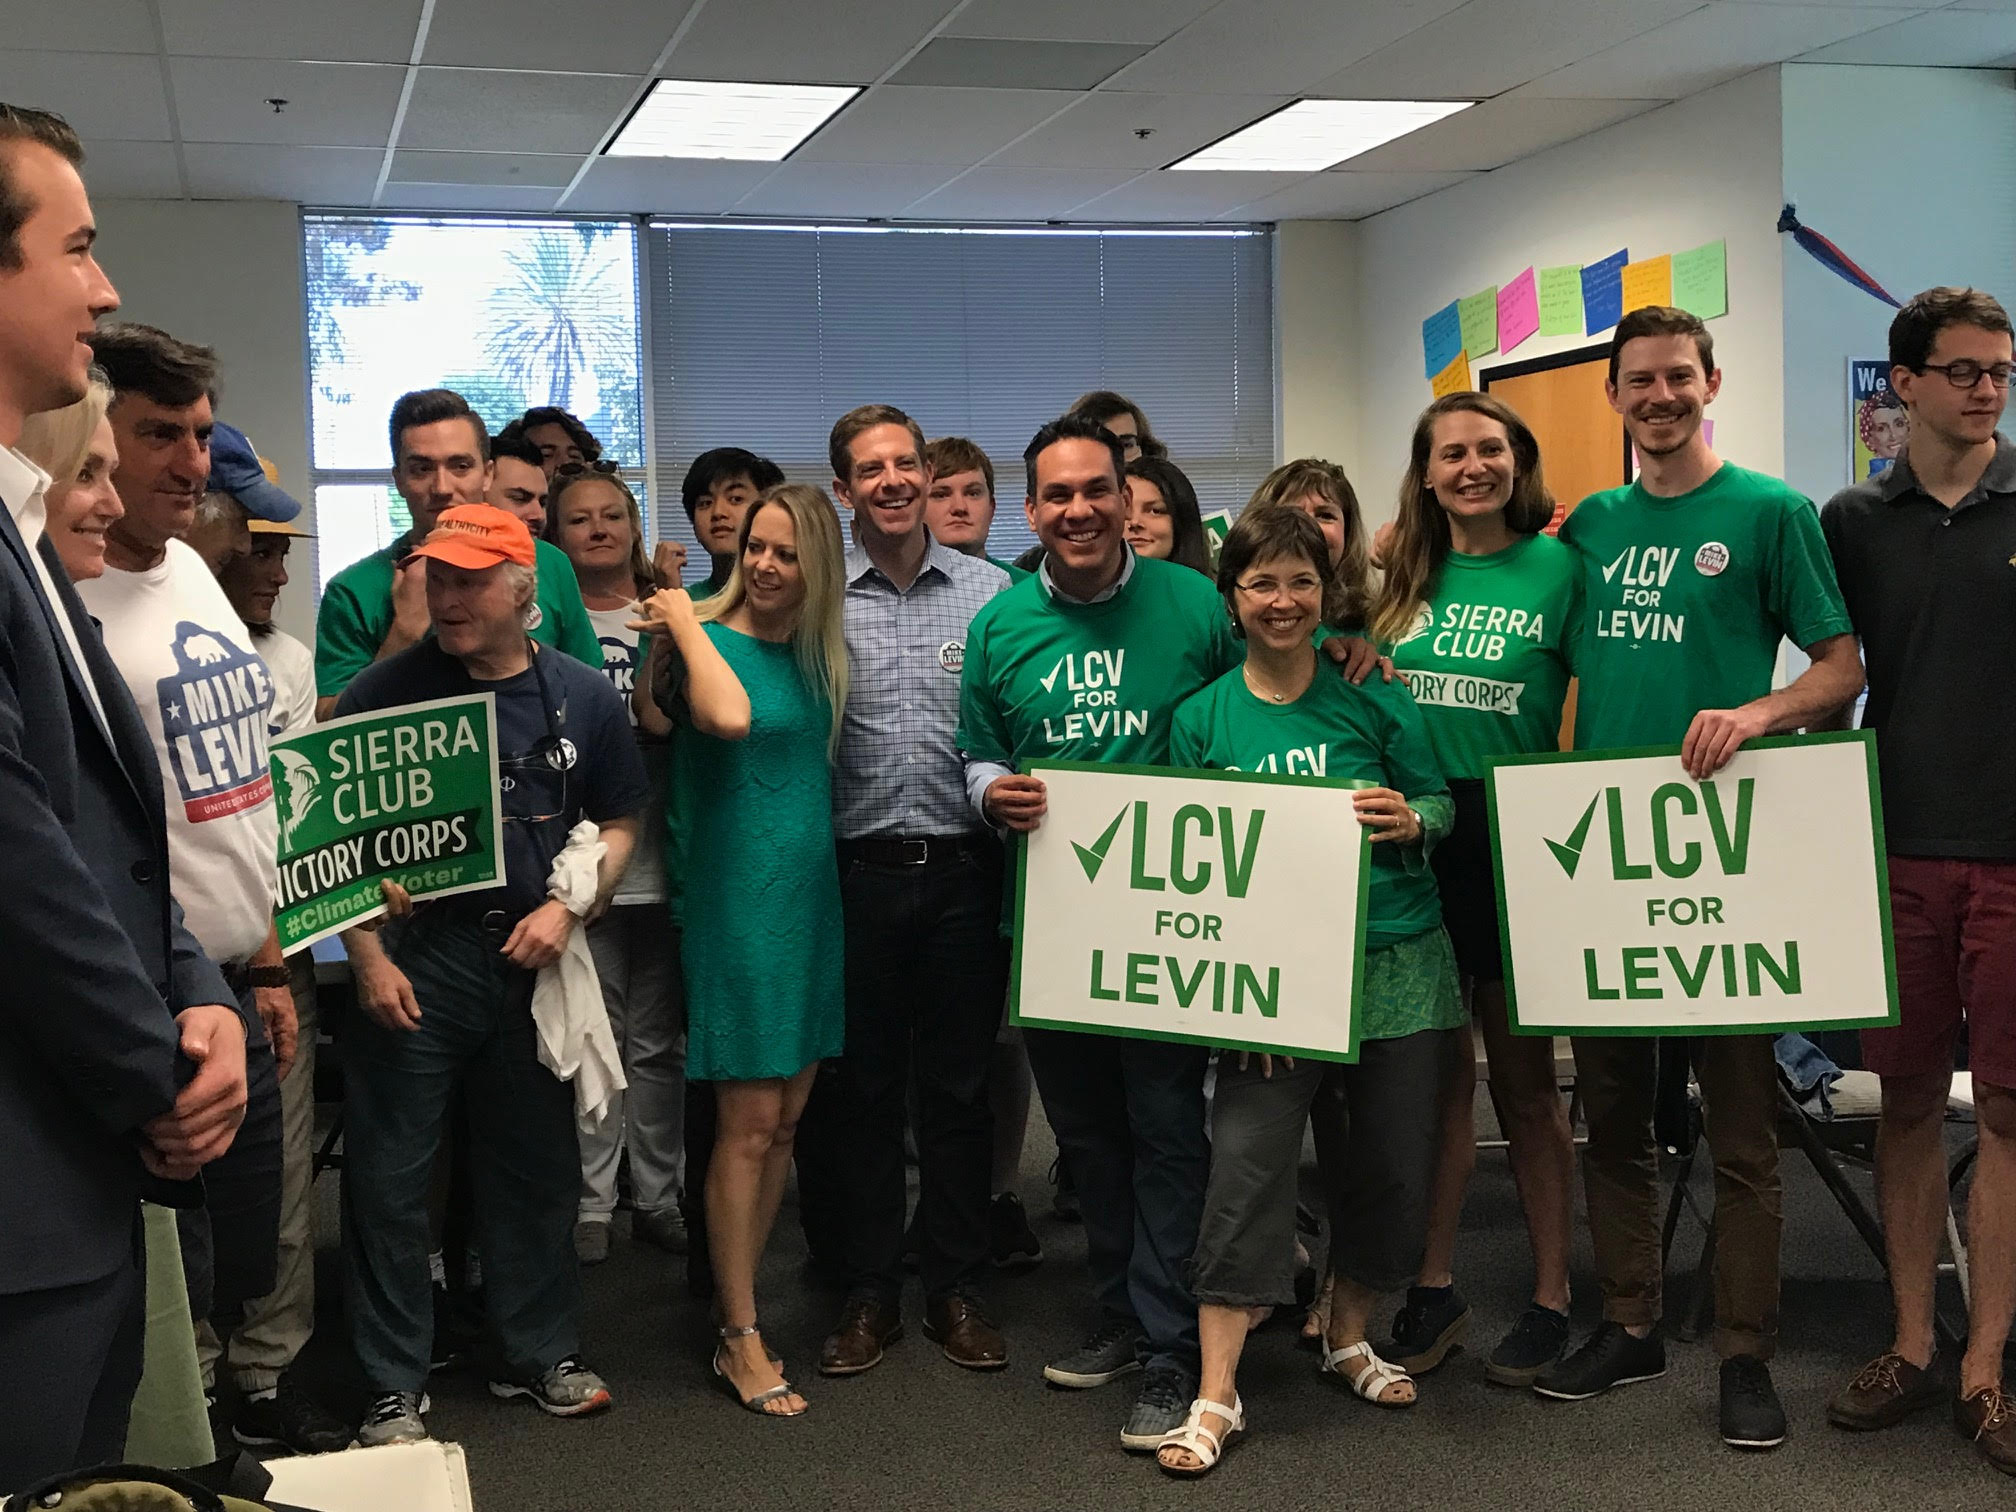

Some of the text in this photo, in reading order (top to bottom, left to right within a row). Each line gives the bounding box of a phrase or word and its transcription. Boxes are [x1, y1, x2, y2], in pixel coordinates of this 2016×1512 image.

[1858, 368, 1887, 391] We
[1622, 545, 1681, 587] LCV
[1698, 554, 1723, 569] LEVIN
[1622, 589, 1661, 607] FOR
[1441, 603, 1544, 643] SIERRA
[1597, 610, 1685, 643] LEVIN
[1433, 631, 1506, 661] CLUB
[1066, 648, 1125, 691] LCV
[181, 663, 269, 726] MIKE
[1073, 690, 1117, 708] FOR
[1454, 679, 1514, 711] CORPS
[1042, 710, 1149, 743] LEVIN
[328, 715, 480, 781] SIERRA
[204, 799, 233, 814] UNITE
[333, 768, 435, 825] CLUB
[1605, 777, 1755, 881] LCV
[274, 815, 468, 909] VICTORY CORPS
[1130, 800, 1266, 899] LCV
[1155, 910, 1223, 942] FOR
[1646, 896, 1725, 927] FOR
[1090, 949, 1280, 1019] LEVIN
[1583, 940, 1802, 1000] LEVIN
